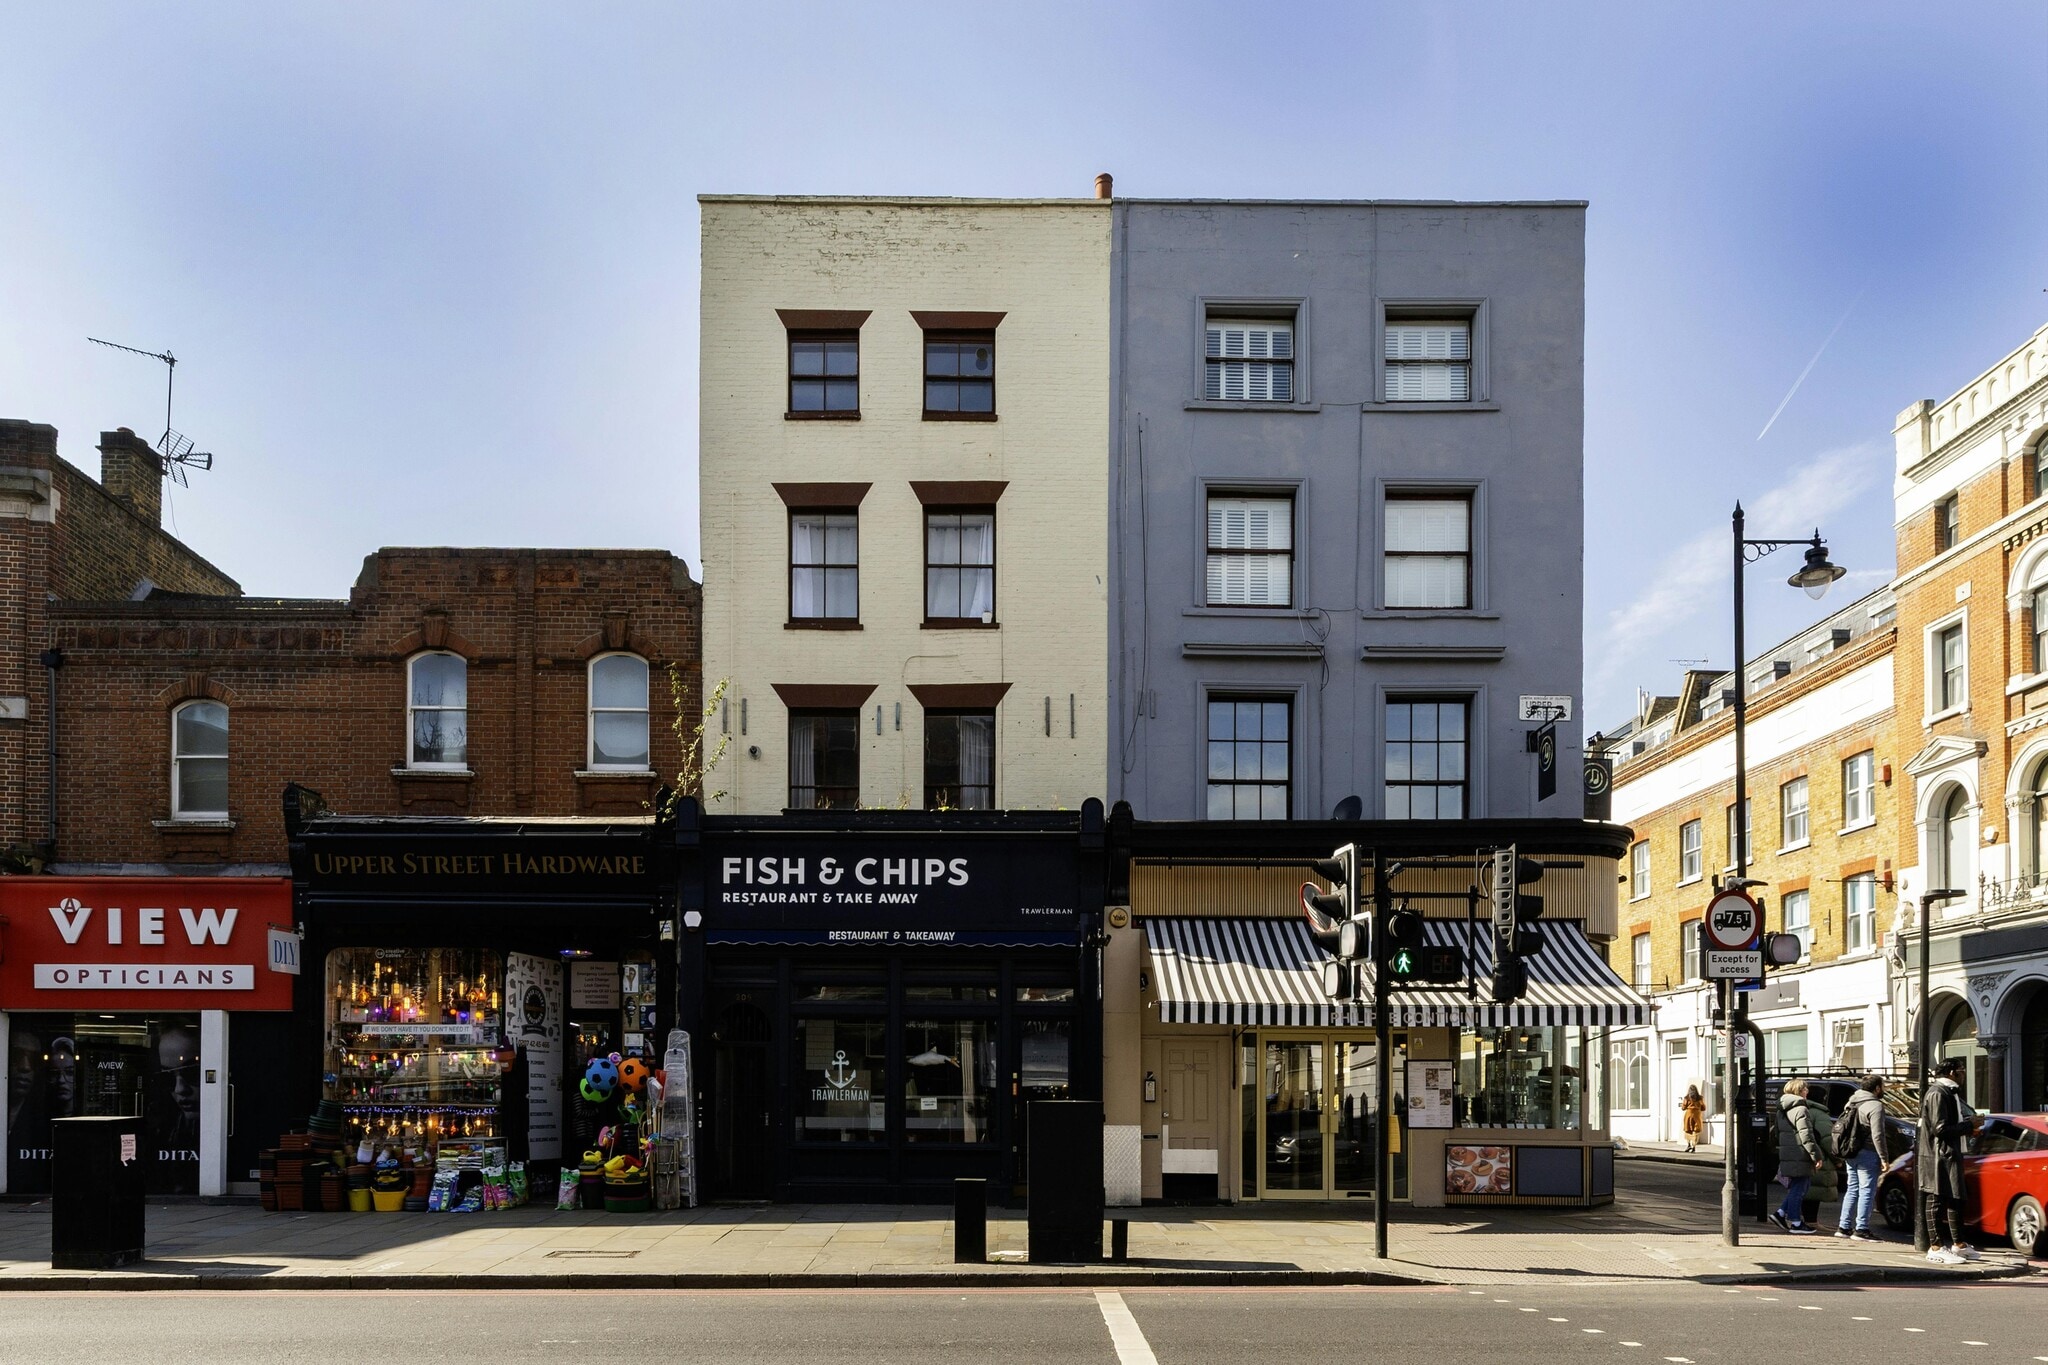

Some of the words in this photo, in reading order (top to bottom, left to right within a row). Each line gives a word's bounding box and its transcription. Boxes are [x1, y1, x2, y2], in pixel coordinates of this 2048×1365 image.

[313, 853, 398, 875] UPPER
[403, 852, 495, 875] STREET
[502, 853, 646, 875] HARDWARE
[722, 857, 805, 885] FISH
[818, 857, 844, 886] &
[854, 857, 970, 886] CHIPS
[723, 892, 818, 904] RESTAURANT
[822, 892, 832, 904] &
[836, 893, 873, 904] TAKE
[878, 893, 919, 904] AWAY
[1020, 907, 1073, 915] TRAWLERMAN
[829, 931, 889, 941] RESTAURANT
[893, 932, 900, 941] &
[905, 932, 956, 941] TAKEAWAY
[1712, 955, 1743, 964] Except
[1745, 955, 1758, 963] for
[1719, 965, 1750, 974] access
[53, 969, 234, 985] OPTICIANS
[1330, 1012, 1397, 1024] PHILIPE
[1403, 1012, 1479, 1024] CONTICINI
[97, 1061, 124, 1070] AVIEW
[811, 1089, 870, 1101] TRAWLERMAN
[158, 1150, 200, 1161] DITA
